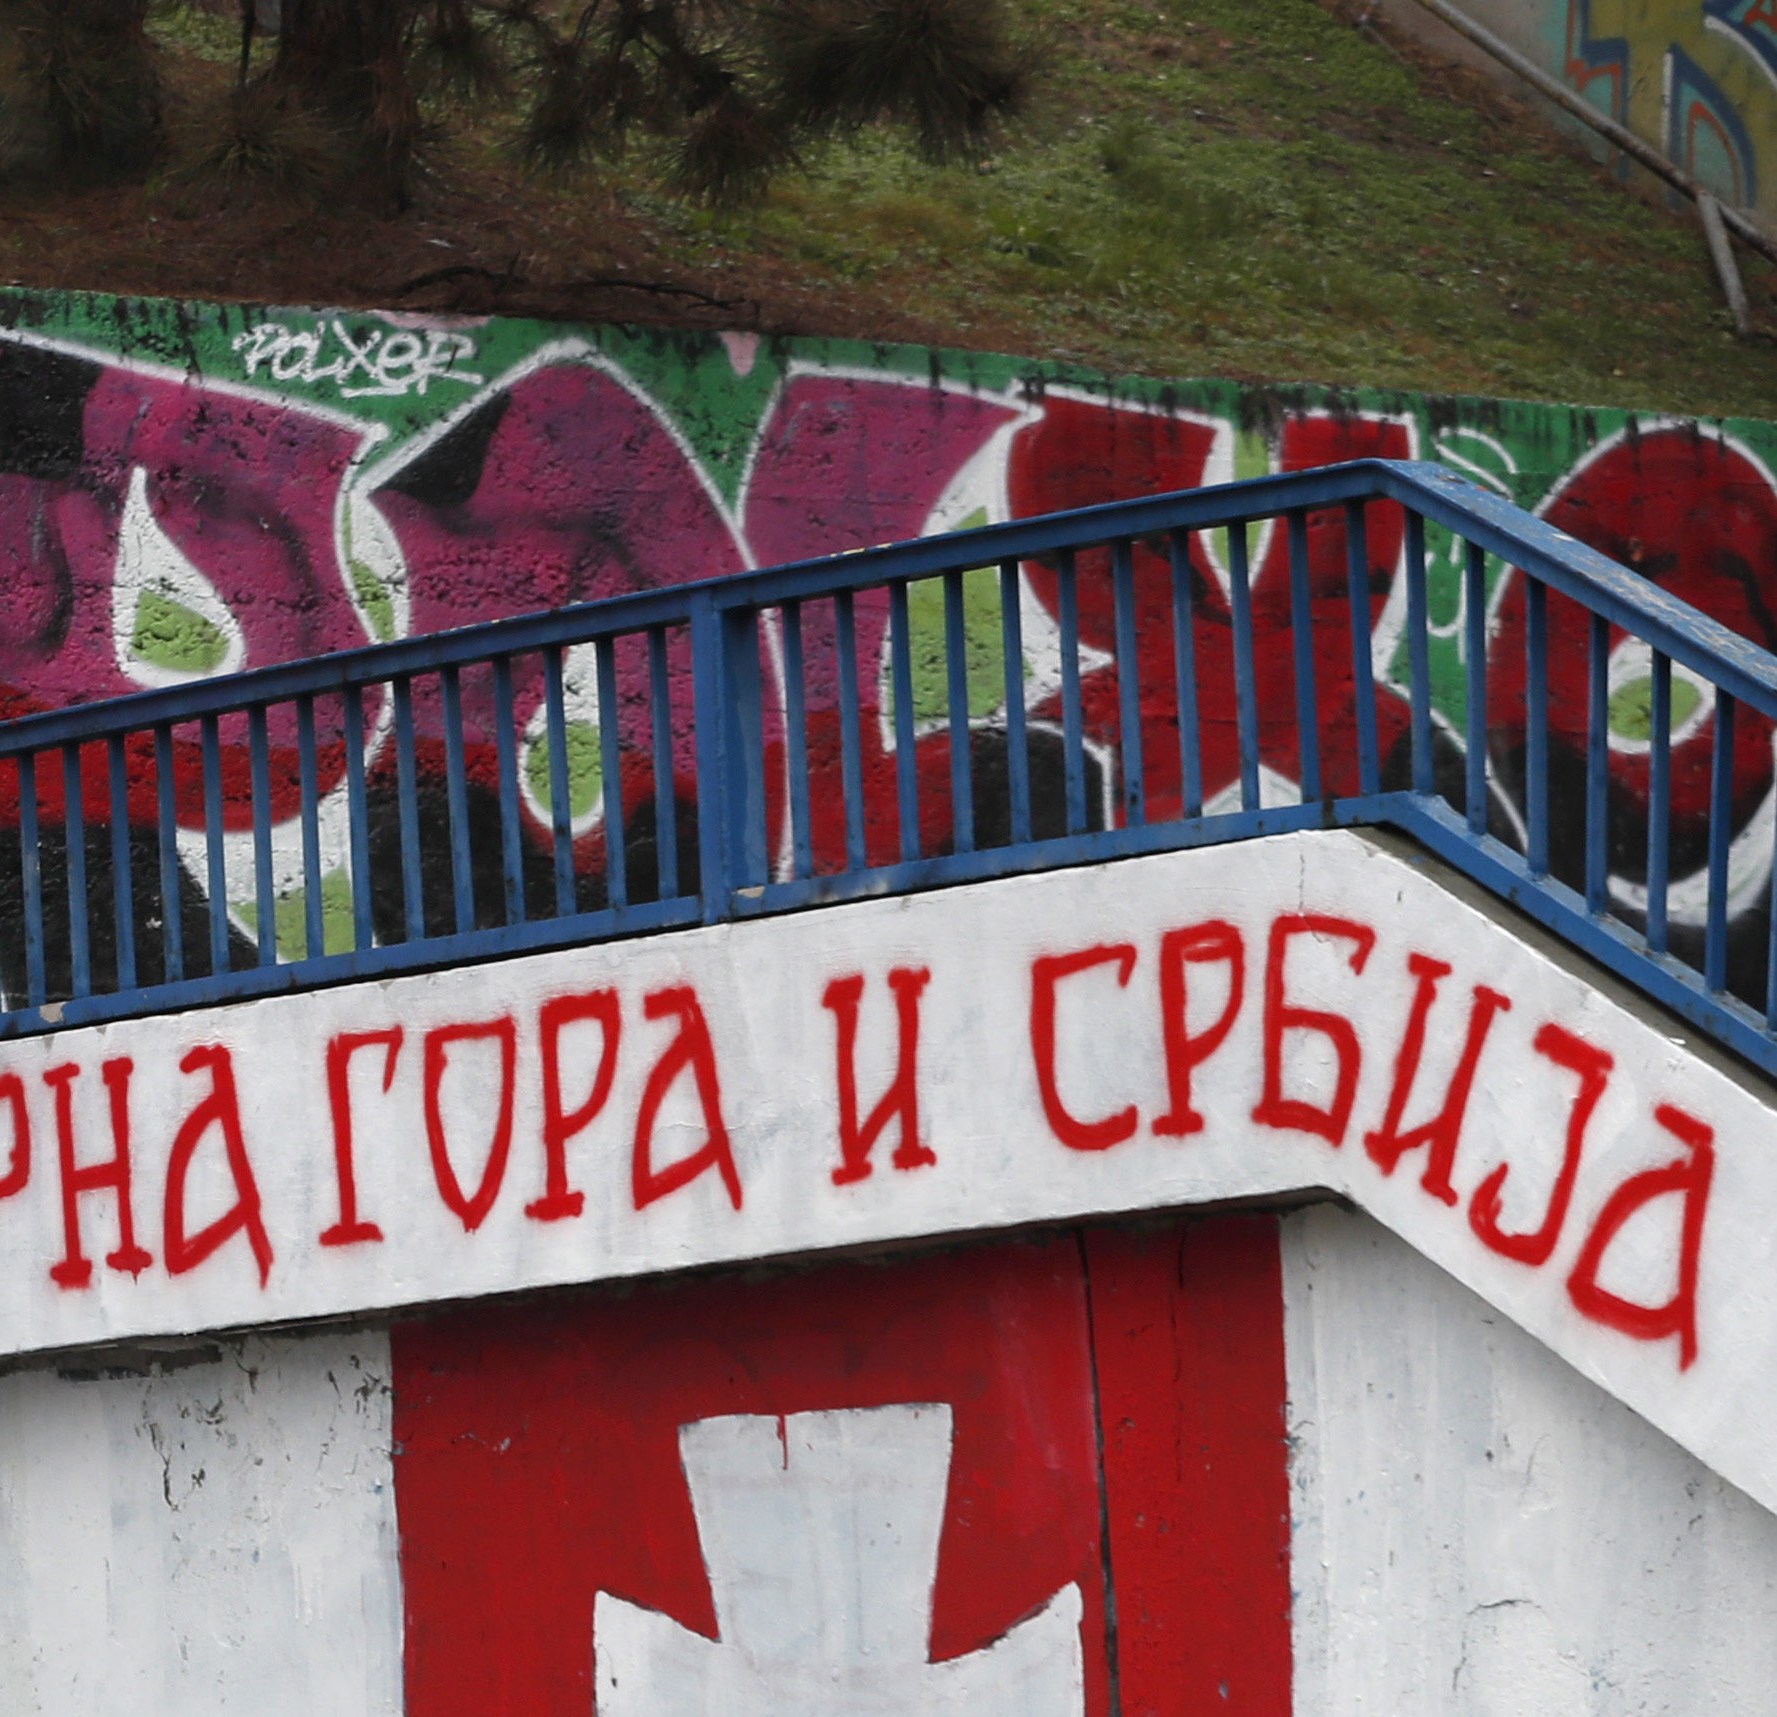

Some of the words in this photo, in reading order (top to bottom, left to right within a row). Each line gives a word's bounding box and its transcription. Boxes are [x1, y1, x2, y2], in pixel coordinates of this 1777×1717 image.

[319, 986, 742, 1247] ГОРА
[822, 967, 937, 1186] И
[1030, 914, 1715, 1371] СРБИЈА
